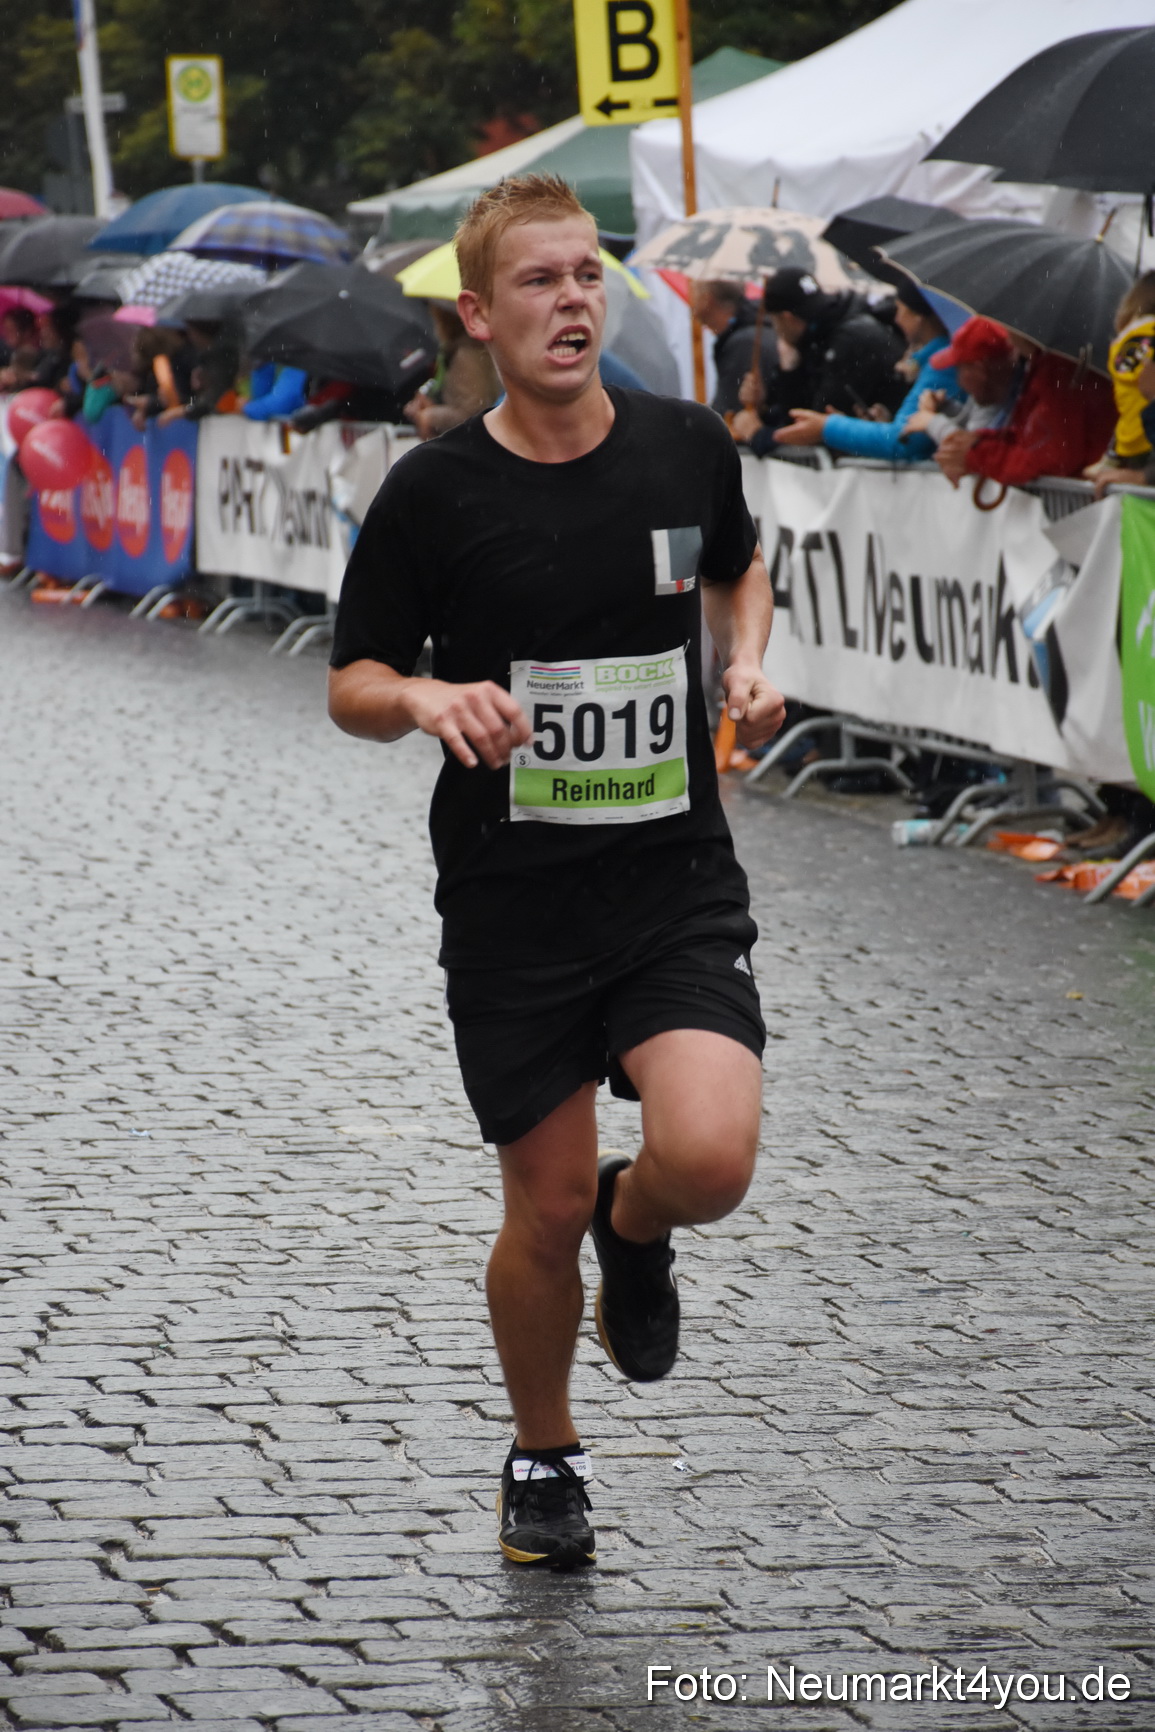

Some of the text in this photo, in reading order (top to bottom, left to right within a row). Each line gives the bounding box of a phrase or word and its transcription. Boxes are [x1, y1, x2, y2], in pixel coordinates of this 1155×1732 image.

[606, 0, 660, 83] B
[526, 679, 585, 691] NeuerMarkt
[595, 657, 675, 685] BOCK
[532, 694, 674, 762] 5019
[519, 755, 526, 766] S
[552, 772, 656, 803] Reinhard
